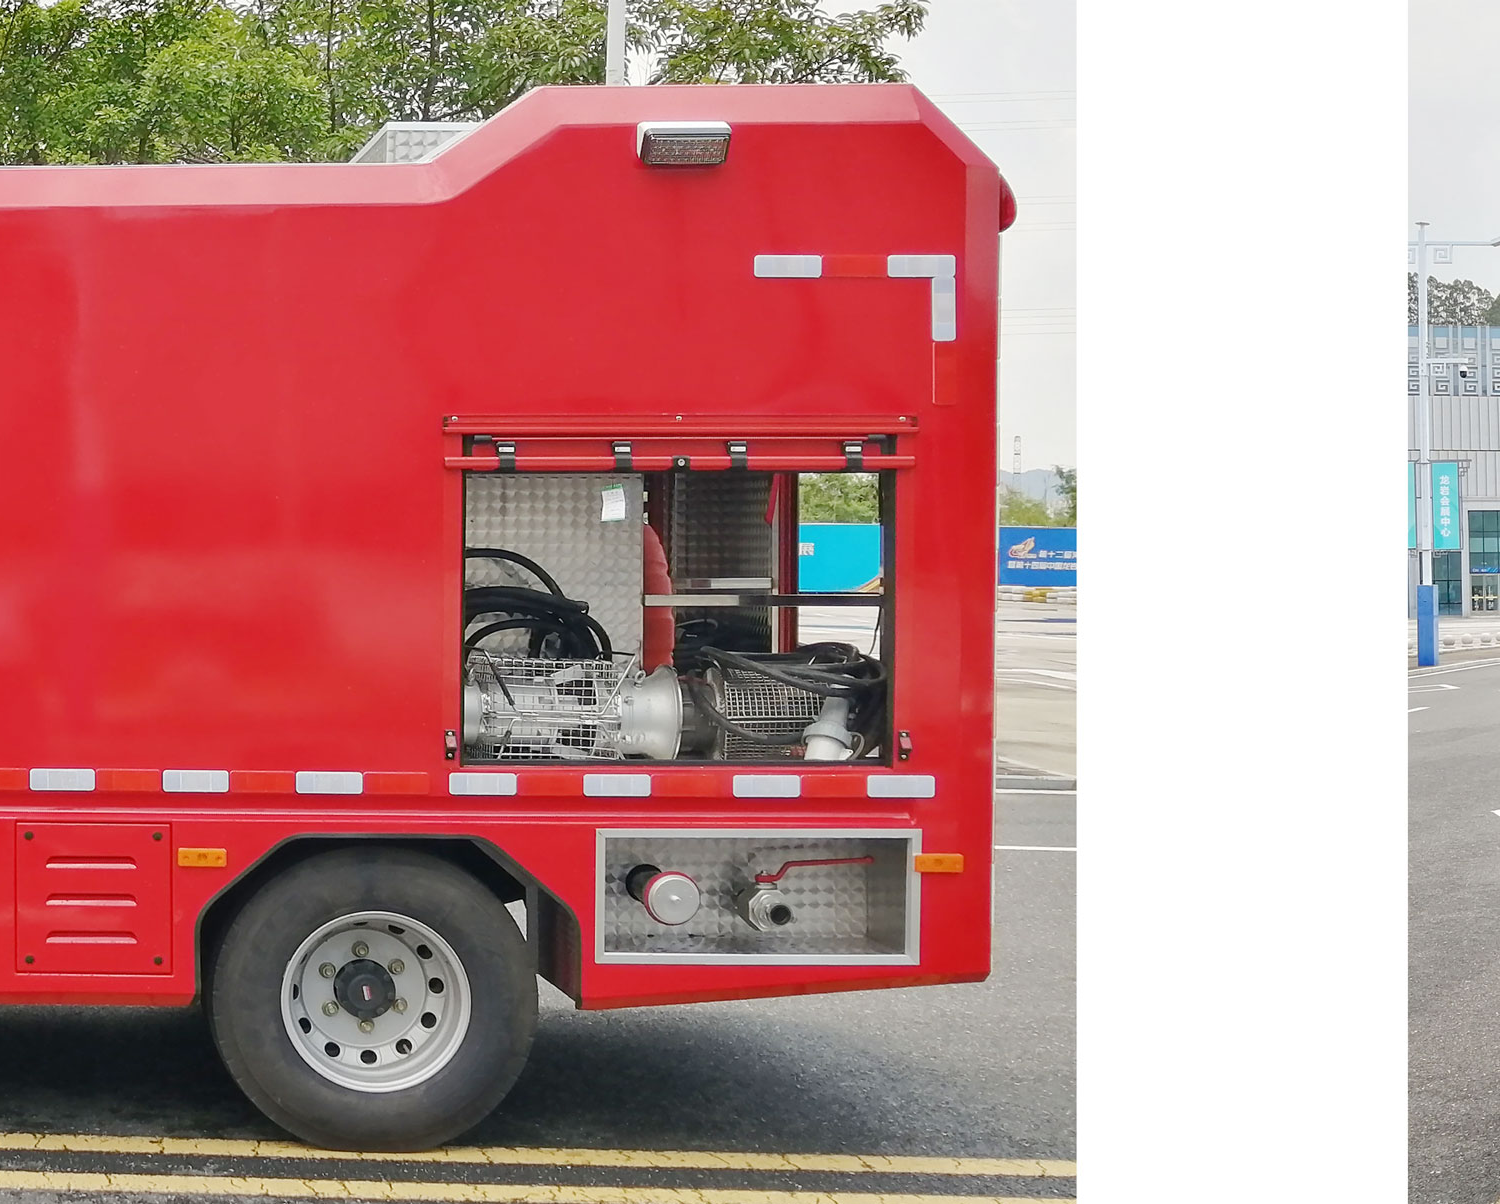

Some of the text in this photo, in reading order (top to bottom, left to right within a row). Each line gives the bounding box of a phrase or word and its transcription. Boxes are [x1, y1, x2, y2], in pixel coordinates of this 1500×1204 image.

[1440, 475, 1451, 537] 龙岩会展中心
